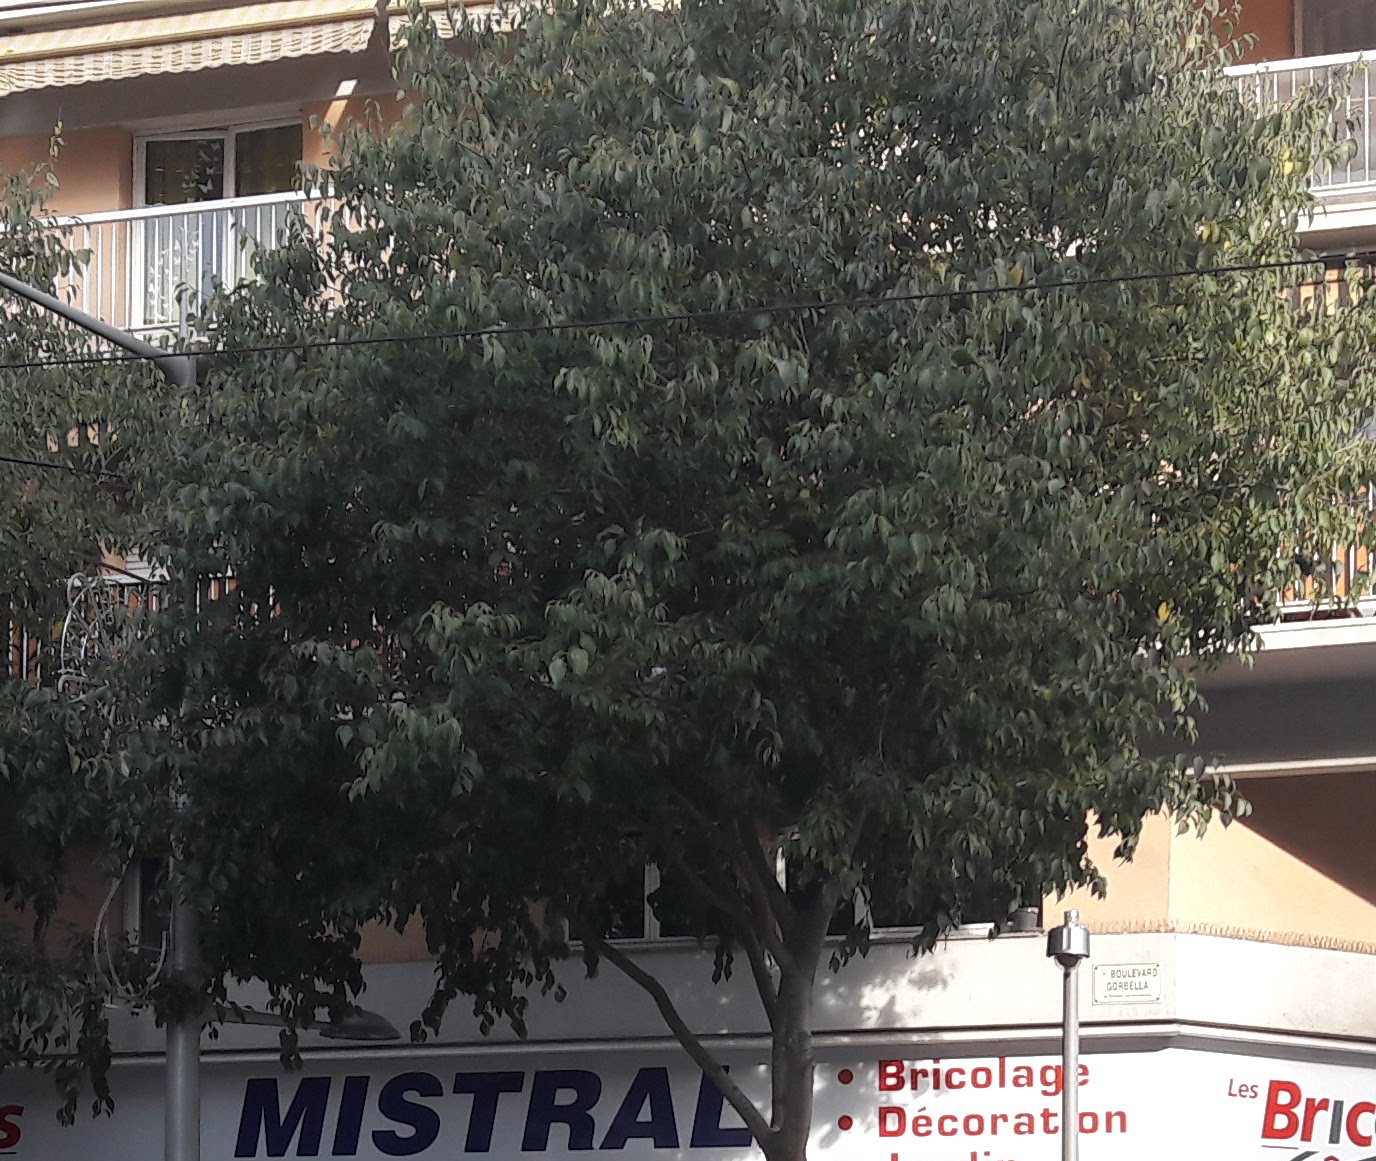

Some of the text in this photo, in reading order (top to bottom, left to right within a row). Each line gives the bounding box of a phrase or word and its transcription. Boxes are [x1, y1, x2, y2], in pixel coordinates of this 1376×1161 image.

[1106, 981, 1149, 991] GORBELLA
[1110, 968, 1158, 978] BOULEVARD
[877, 1056, 1090, 1096] Bricolage
[1228, 1078, 1258, 1098] Les
[233, 1066, 754, 1158] MISTRAL
[877, 1106, 1127, 1138] Décoraton
